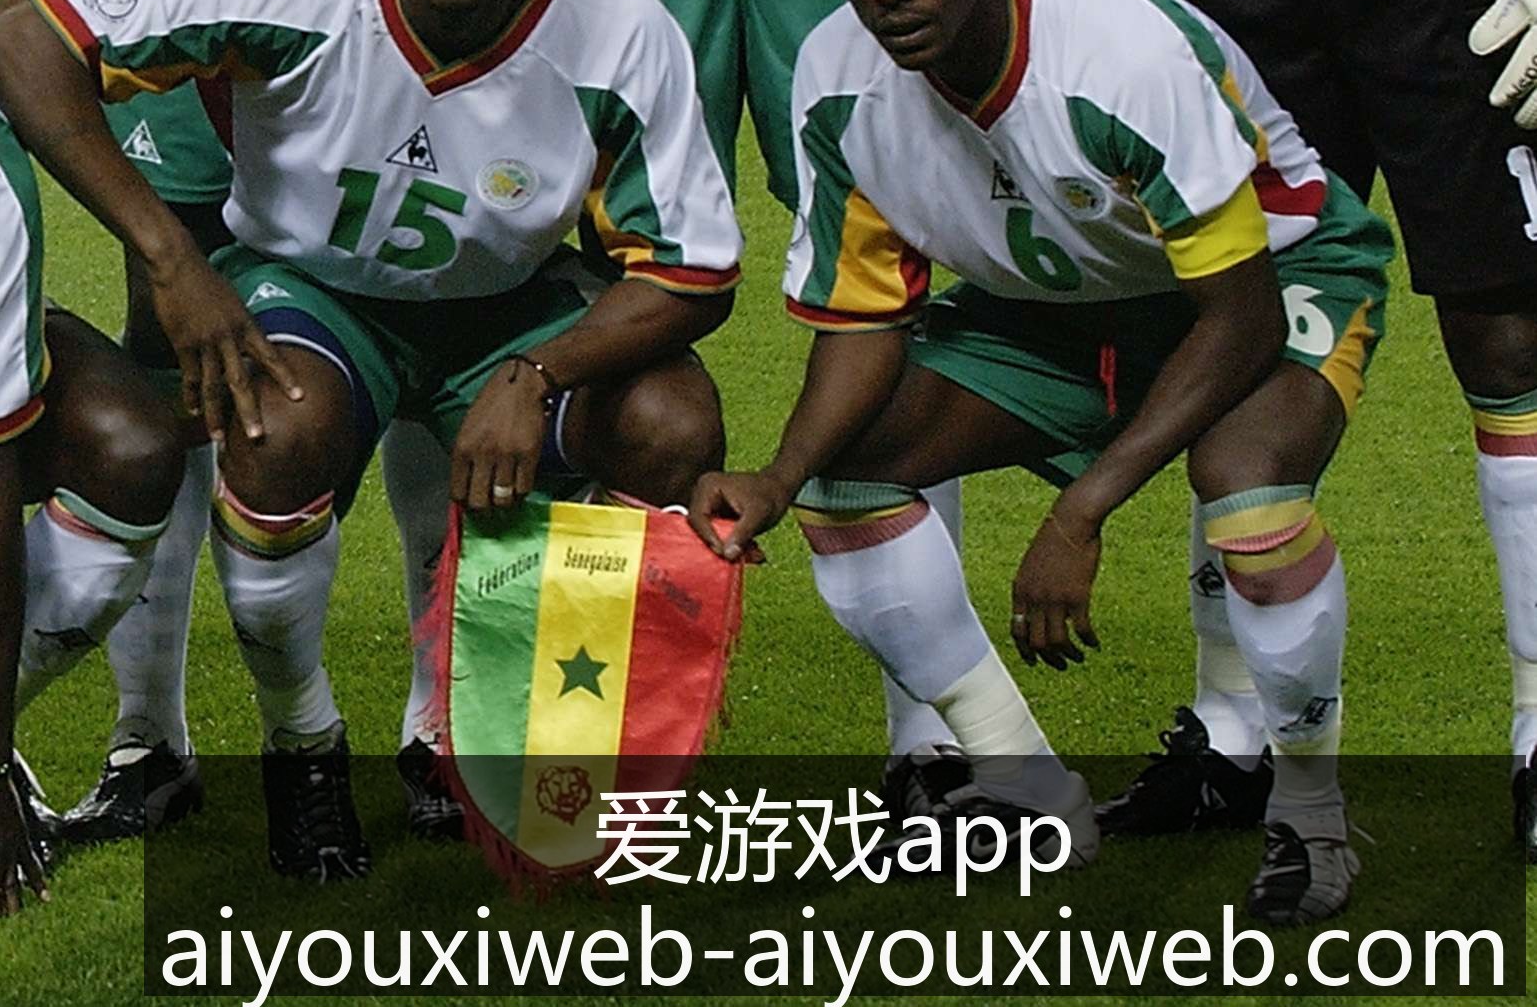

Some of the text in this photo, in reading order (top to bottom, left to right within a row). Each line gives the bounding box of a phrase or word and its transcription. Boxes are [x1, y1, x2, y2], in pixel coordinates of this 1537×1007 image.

[328, 168, 468, 272] 15
[1006, 206, 1083, 292] 6
[1282, 284, 1334, 356] 6
